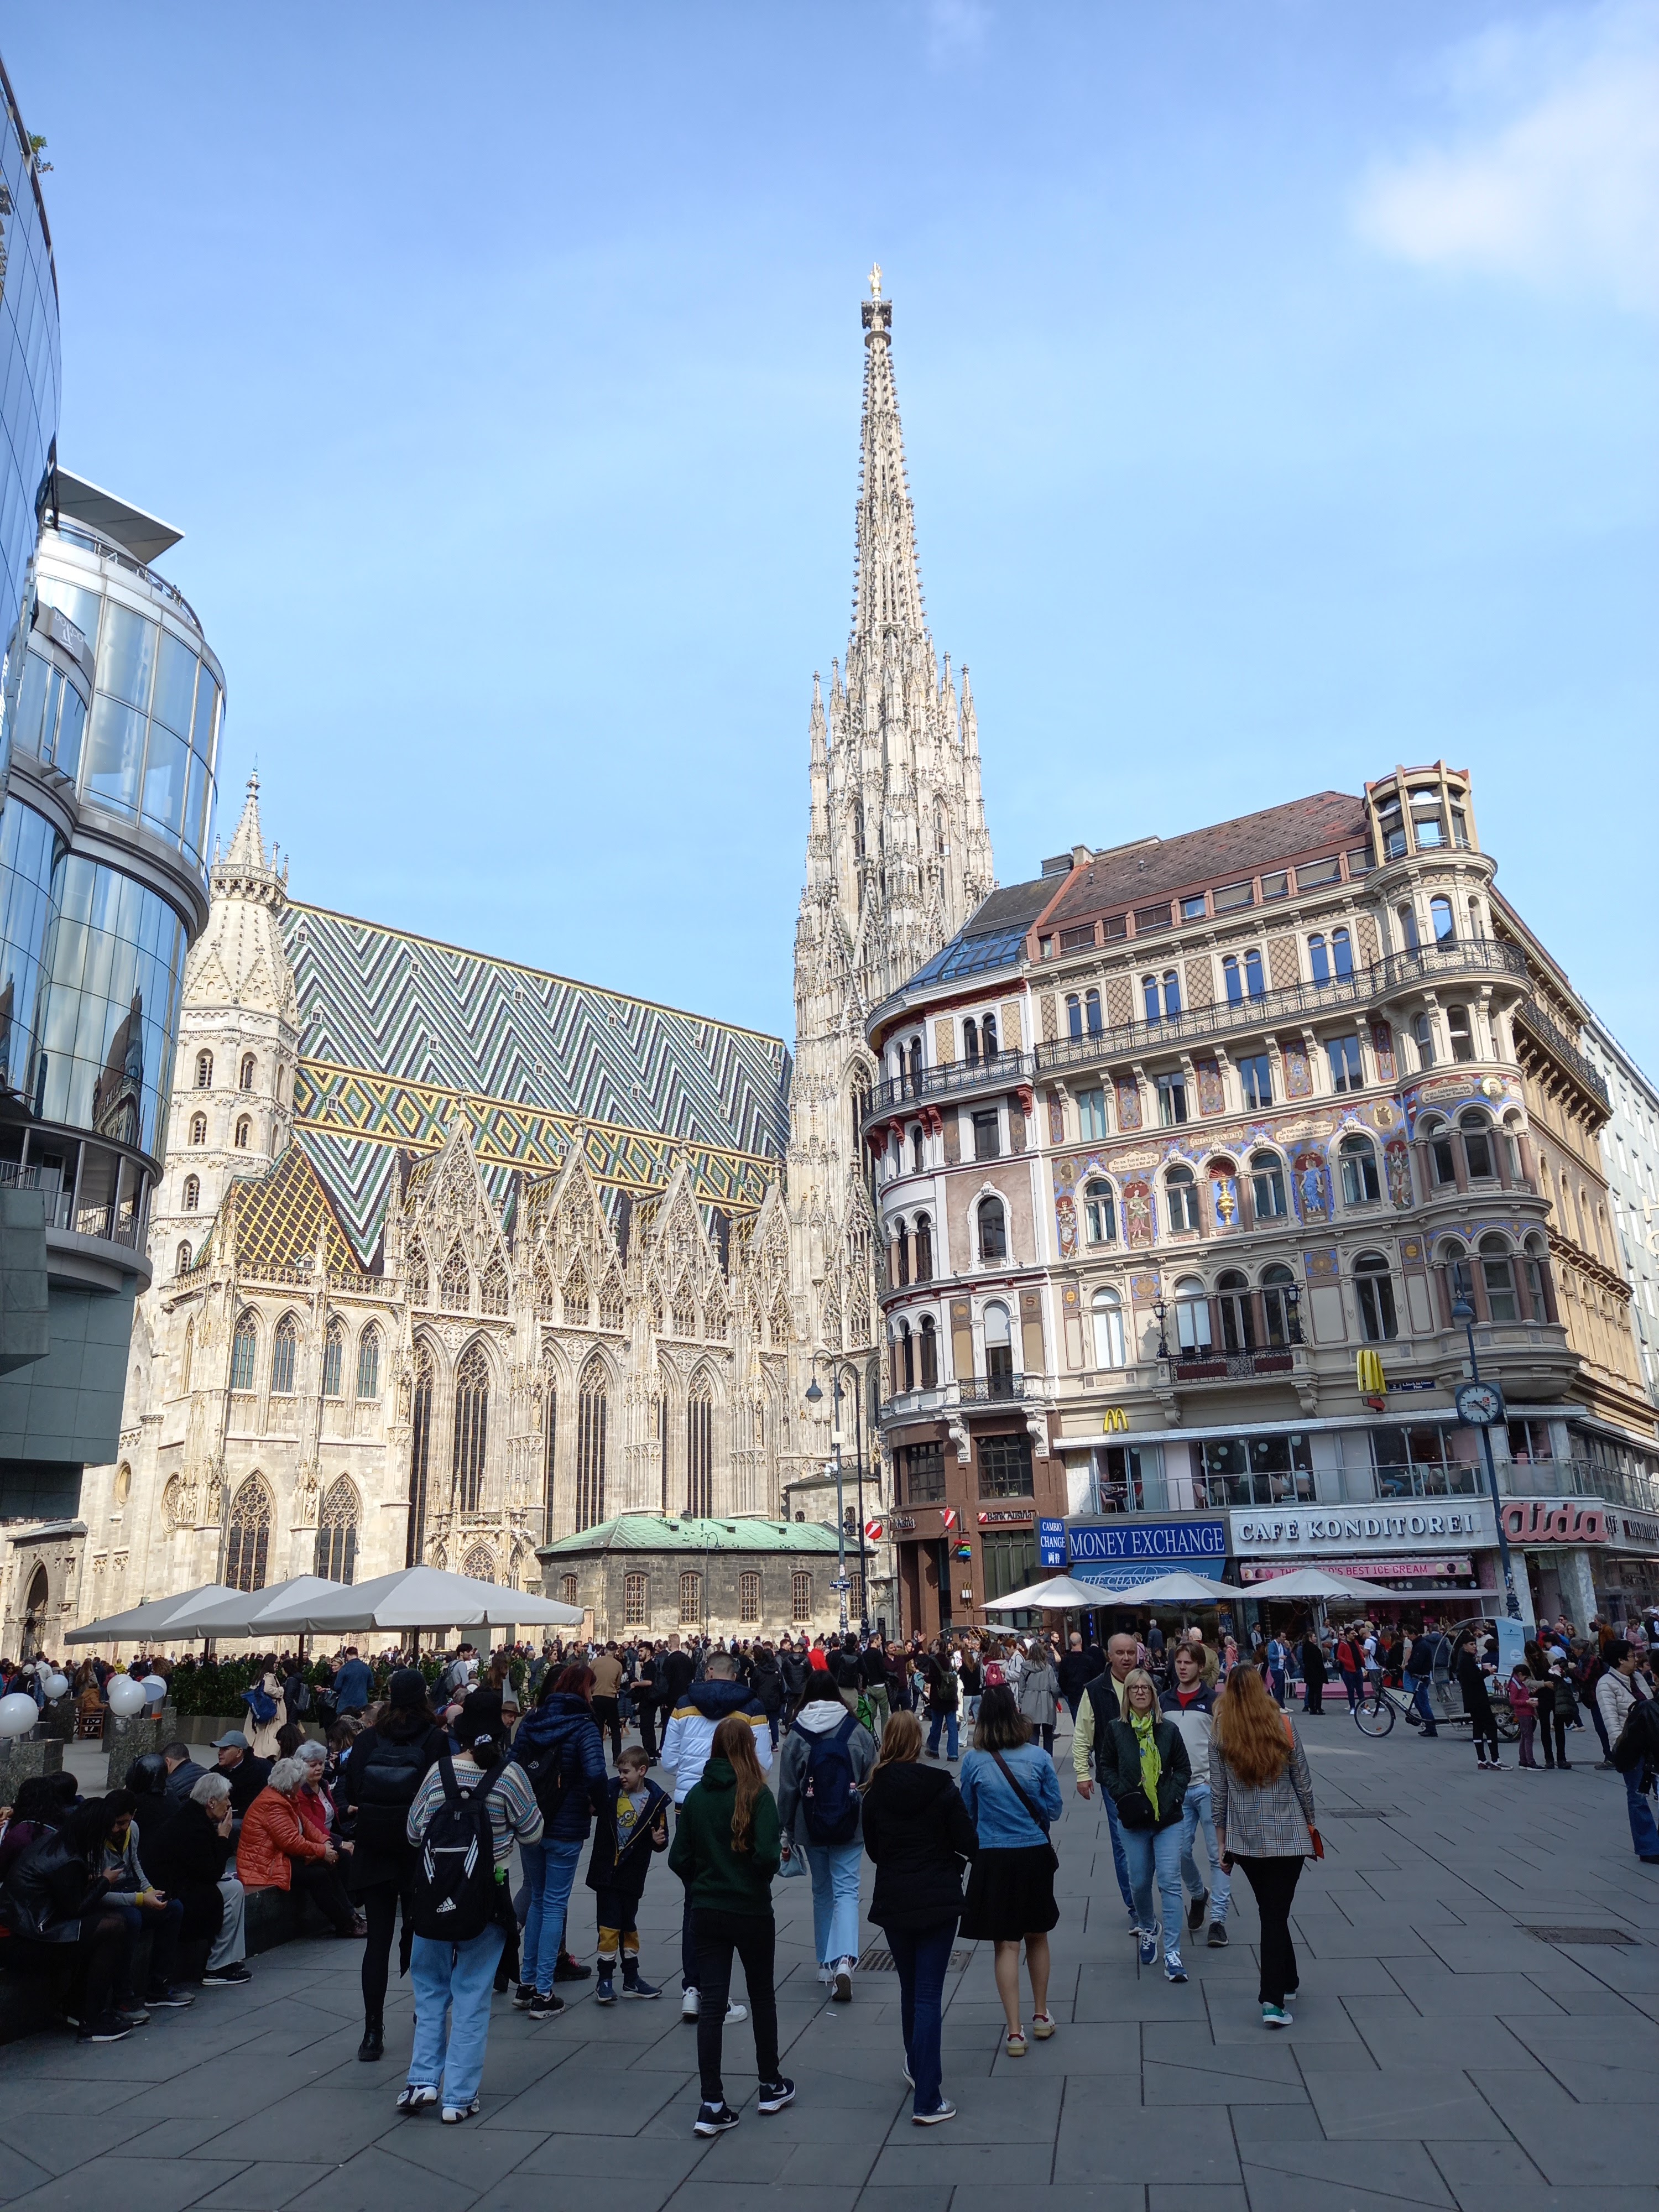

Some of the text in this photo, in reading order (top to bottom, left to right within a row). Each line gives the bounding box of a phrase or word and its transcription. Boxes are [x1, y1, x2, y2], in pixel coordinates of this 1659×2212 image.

[987, 1510, 1032, 1521] Bank Austria
[1042, 1521, 1062, 1532] CAMBIO
[1239, 1514, 1474, 1541] CAFÉ KONDITOREI
[1040, 1536, 1066, 1548] CHANGE
[1068, 1527, 1225, 1556] MONEY EXCHANGE
[1346, 1566, 1370, 1575] BEST
[1373, 1565, 1390, 1574] ICE
[1393, 1564, 1428, 1574] CREAM
[1082, 1576, 1104, 1585] THE
[436, 1903, 457, 1913] adidas
